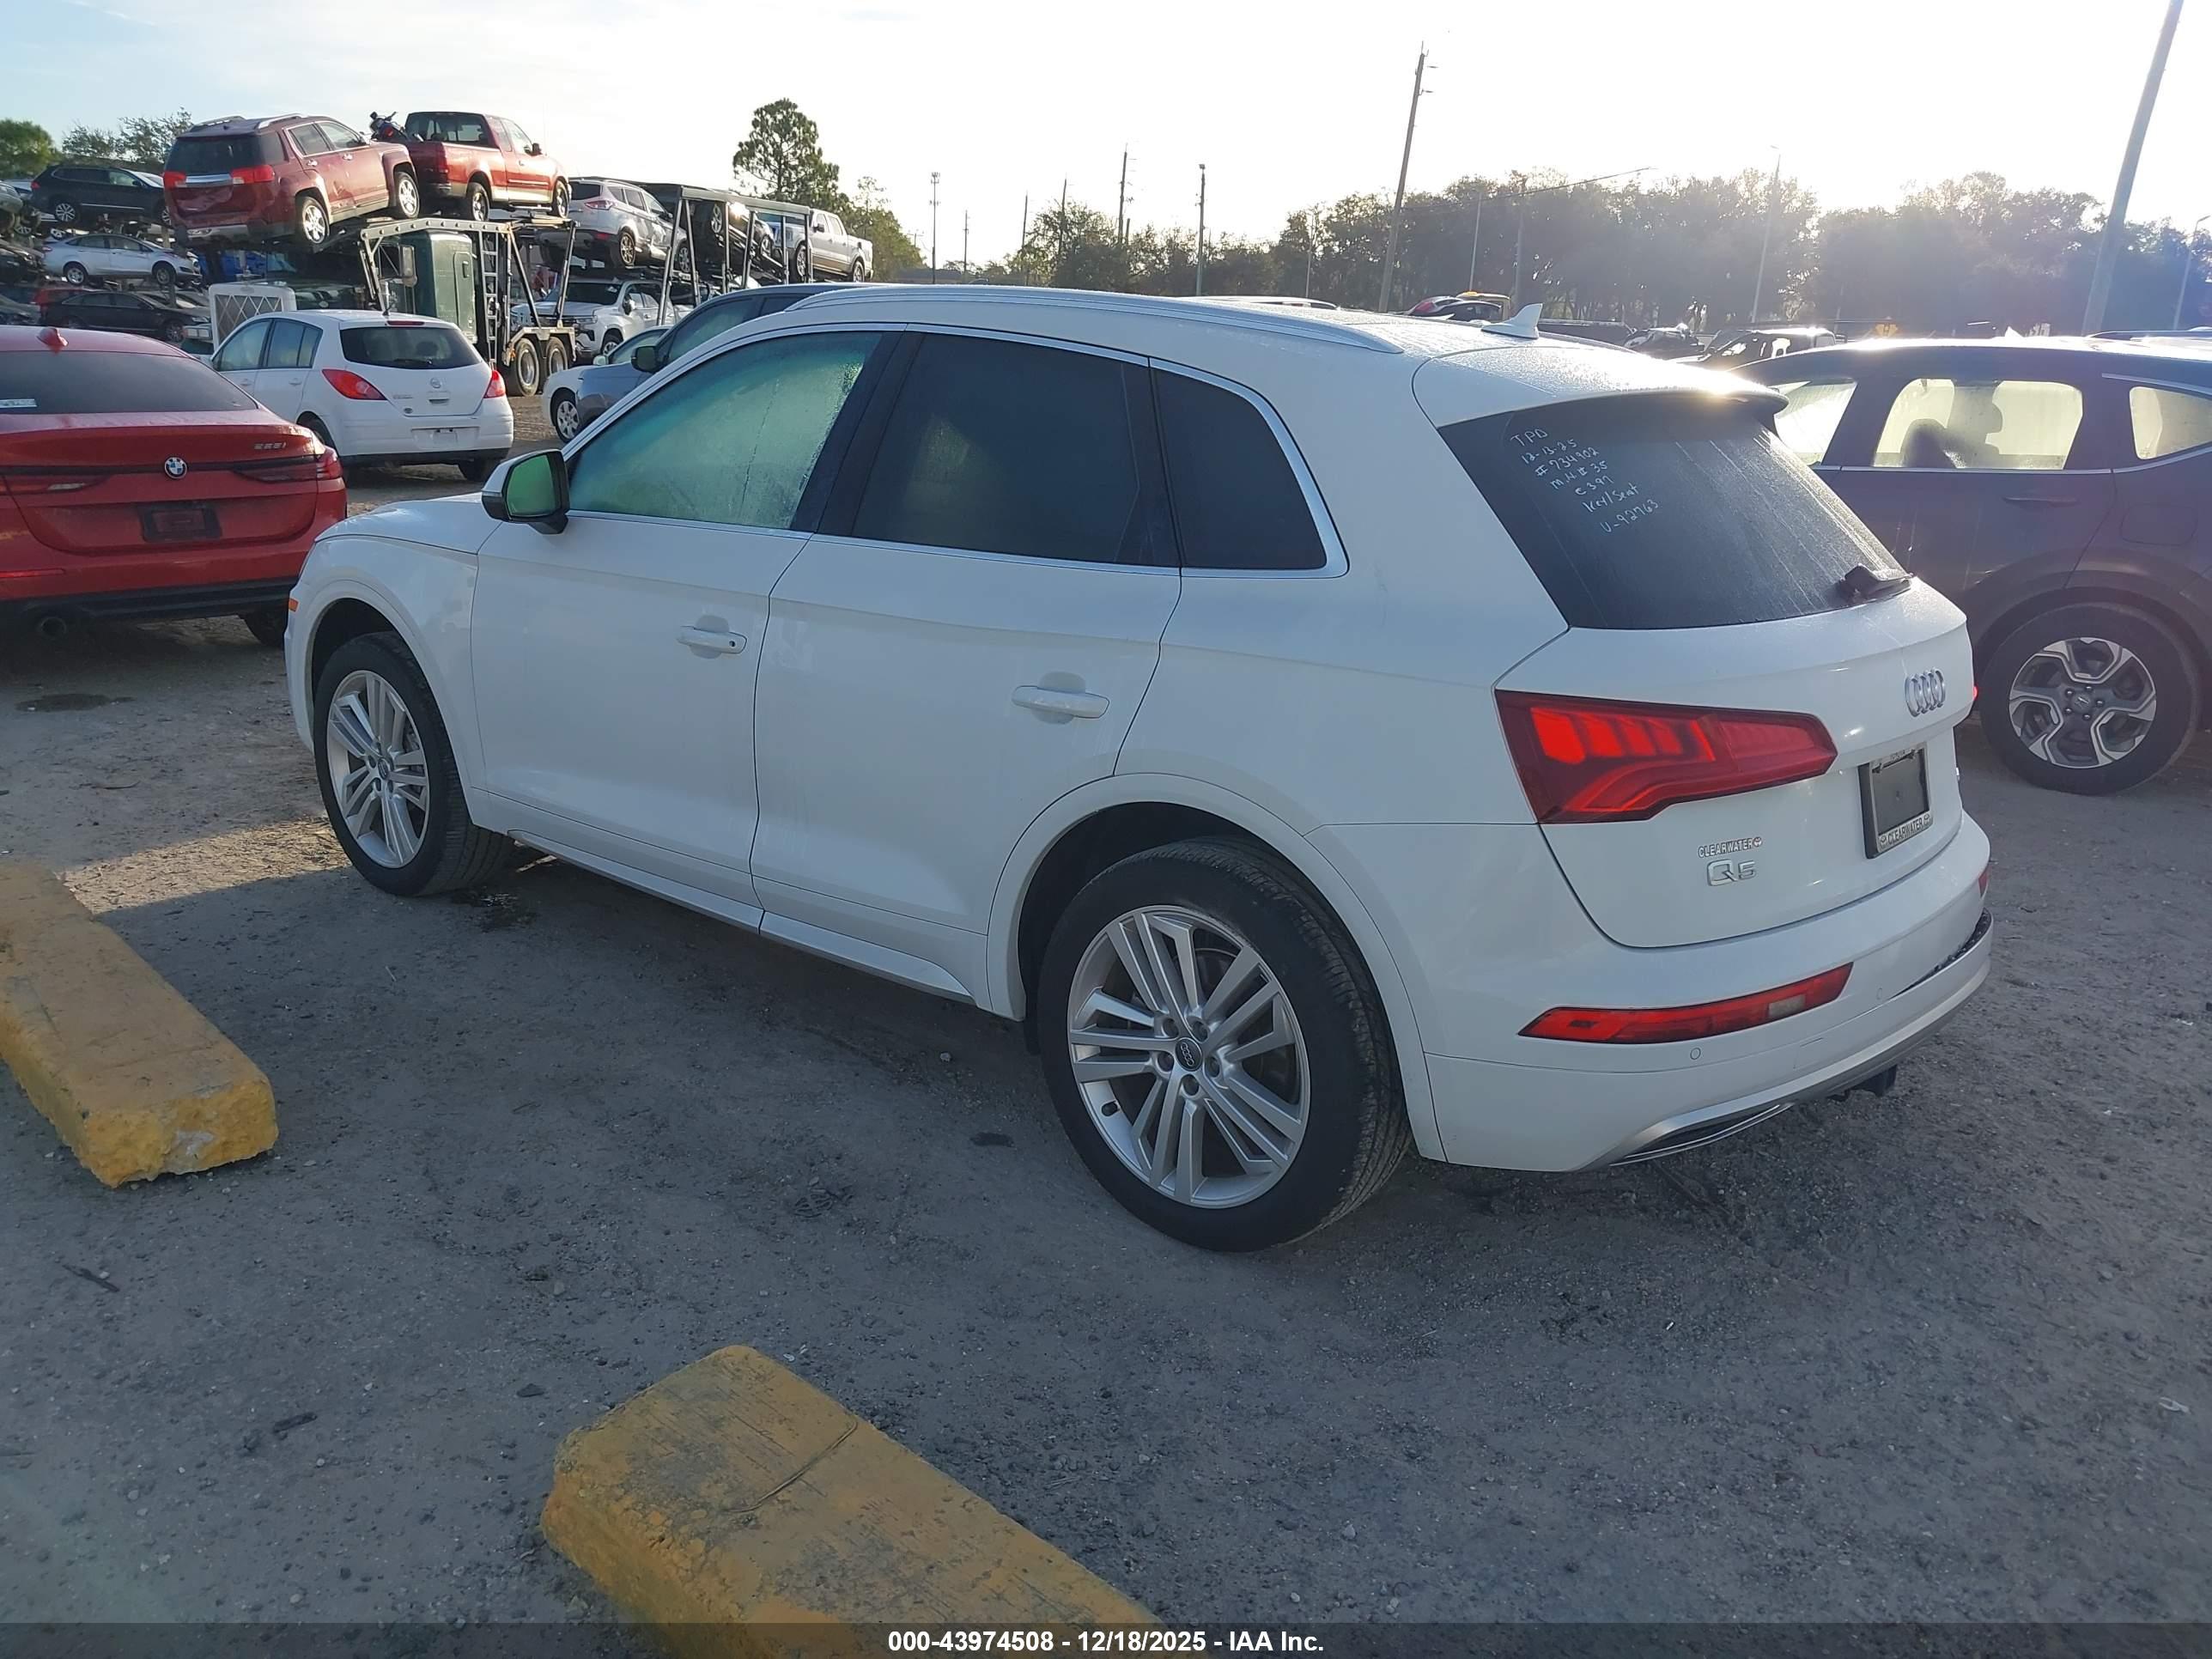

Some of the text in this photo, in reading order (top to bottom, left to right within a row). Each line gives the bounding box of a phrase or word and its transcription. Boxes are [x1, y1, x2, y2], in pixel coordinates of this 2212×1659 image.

[1510, 428, 1548, 447] TPD
[1887, 817, 1923, 846] CLEARWATER
[1698, 837, 1753, 859] CLEARWATER
[1706, 859, 1757, 887] Q5
